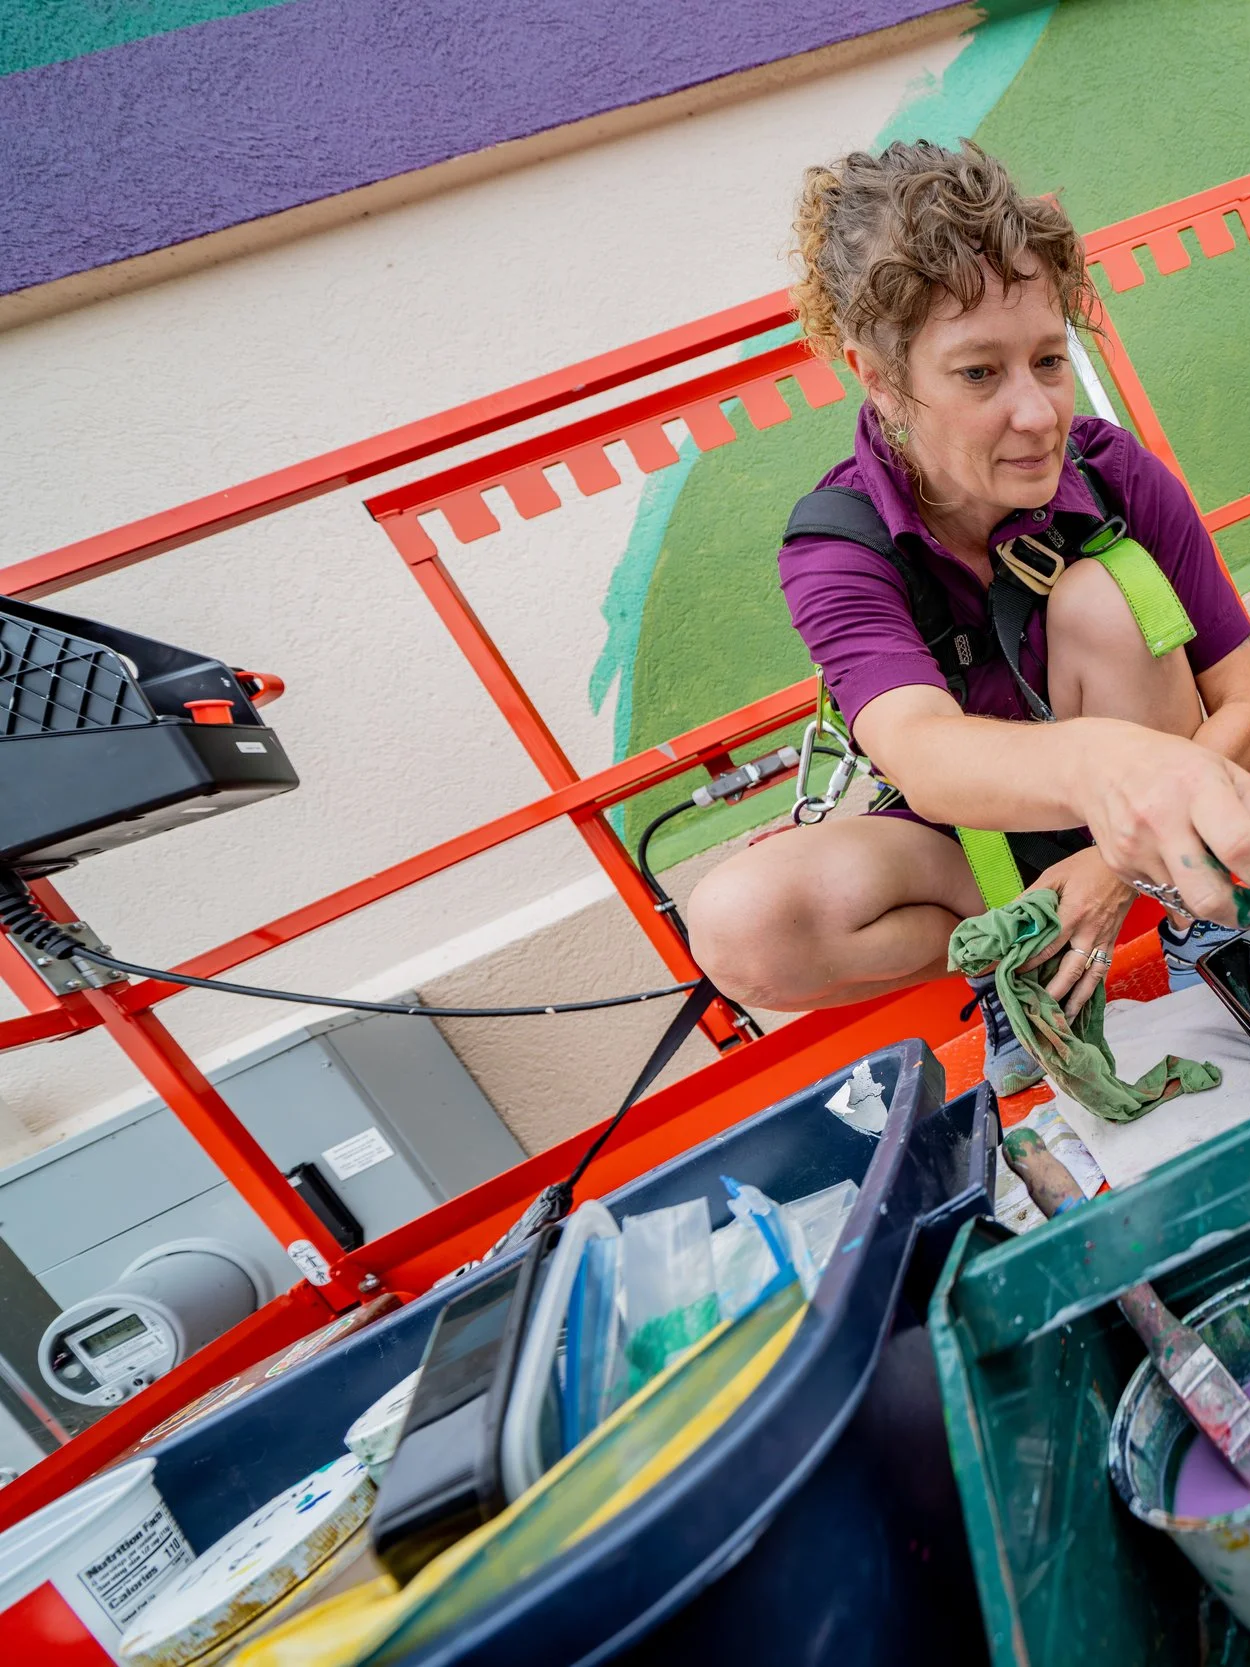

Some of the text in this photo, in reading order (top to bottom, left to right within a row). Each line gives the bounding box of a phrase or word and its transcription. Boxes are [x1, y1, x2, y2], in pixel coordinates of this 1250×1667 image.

[85, 1531, 143, 1579] Nutrition
[142, 1511, 163, 1532] Facts
[109, 1566, 158, 1609] Calories
[164, 1538, 181, 1559] 110
